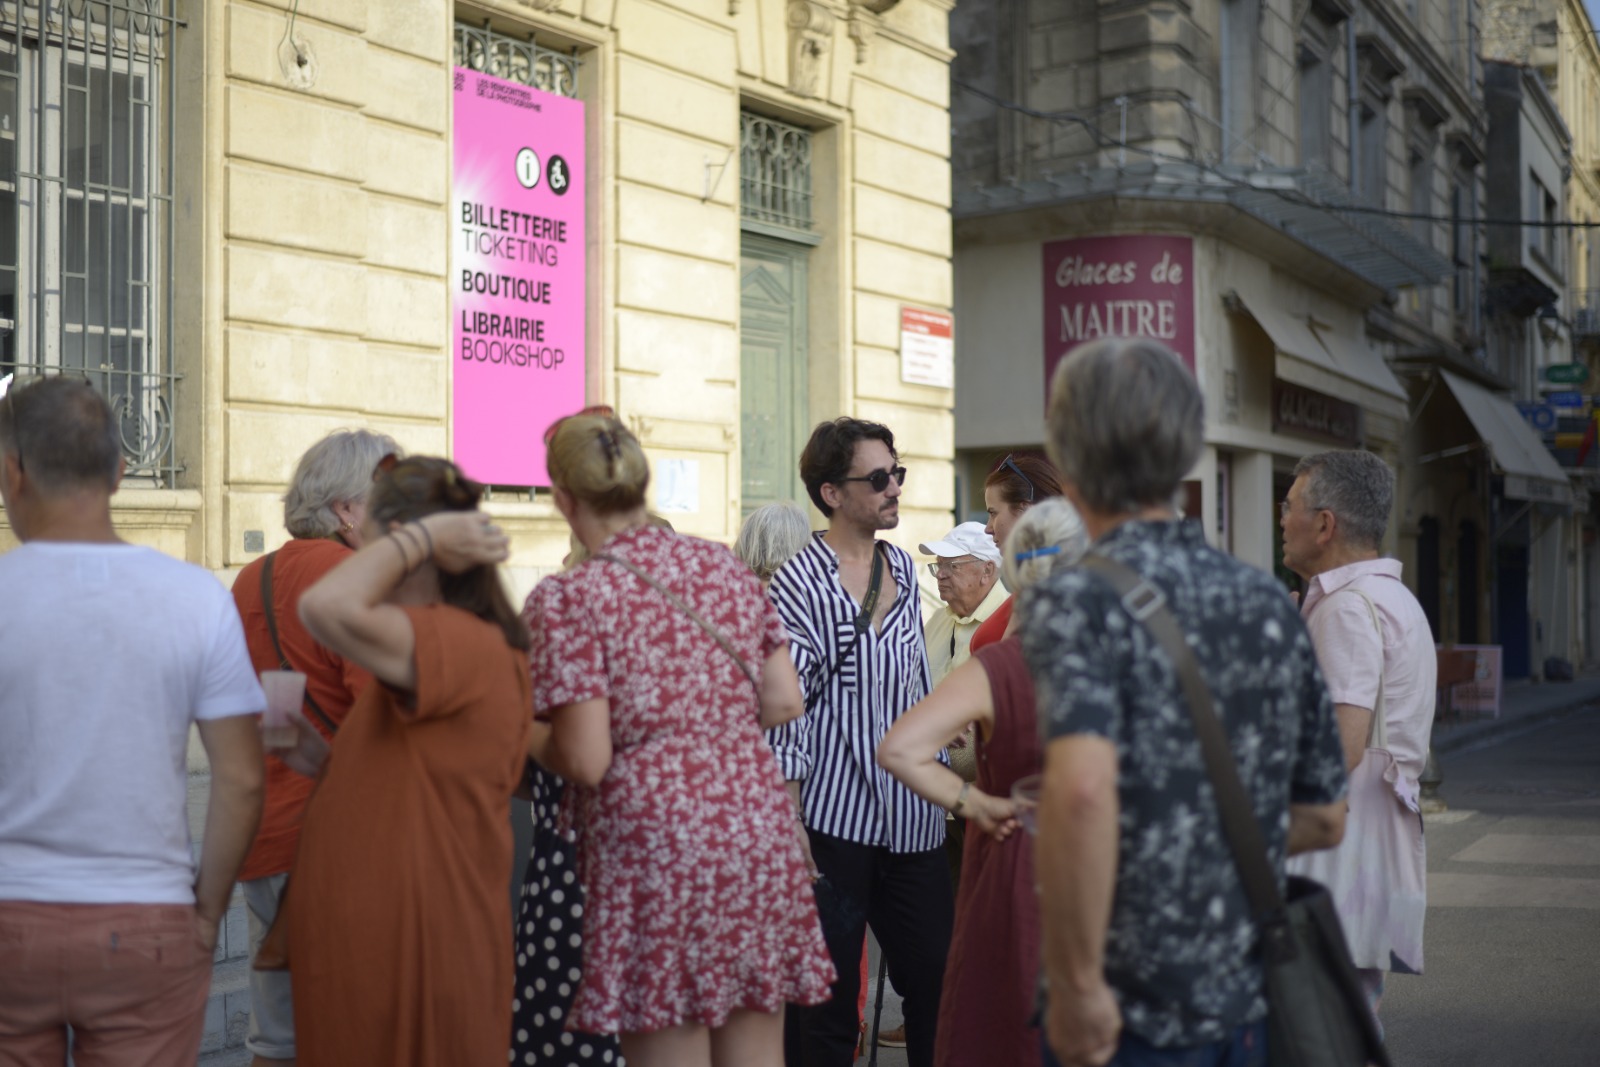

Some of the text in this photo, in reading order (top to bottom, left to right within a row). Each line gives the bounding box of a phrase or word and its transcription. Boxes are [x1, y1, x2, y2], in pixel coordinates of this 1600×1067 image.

[462, 201, 567, 243] BILLETTERIE
[462, 228, 559, 267] TICKETING
[462, 269, 551, 305] BOUTIQUE
[1056, 250, 1183, 288] Glaces de
[462, 309, 545, 342] LIBRAIRIE
[1059, 300, 1177, 343] MAITRE
[462, 337, 565, 371] BOOKSHOP
